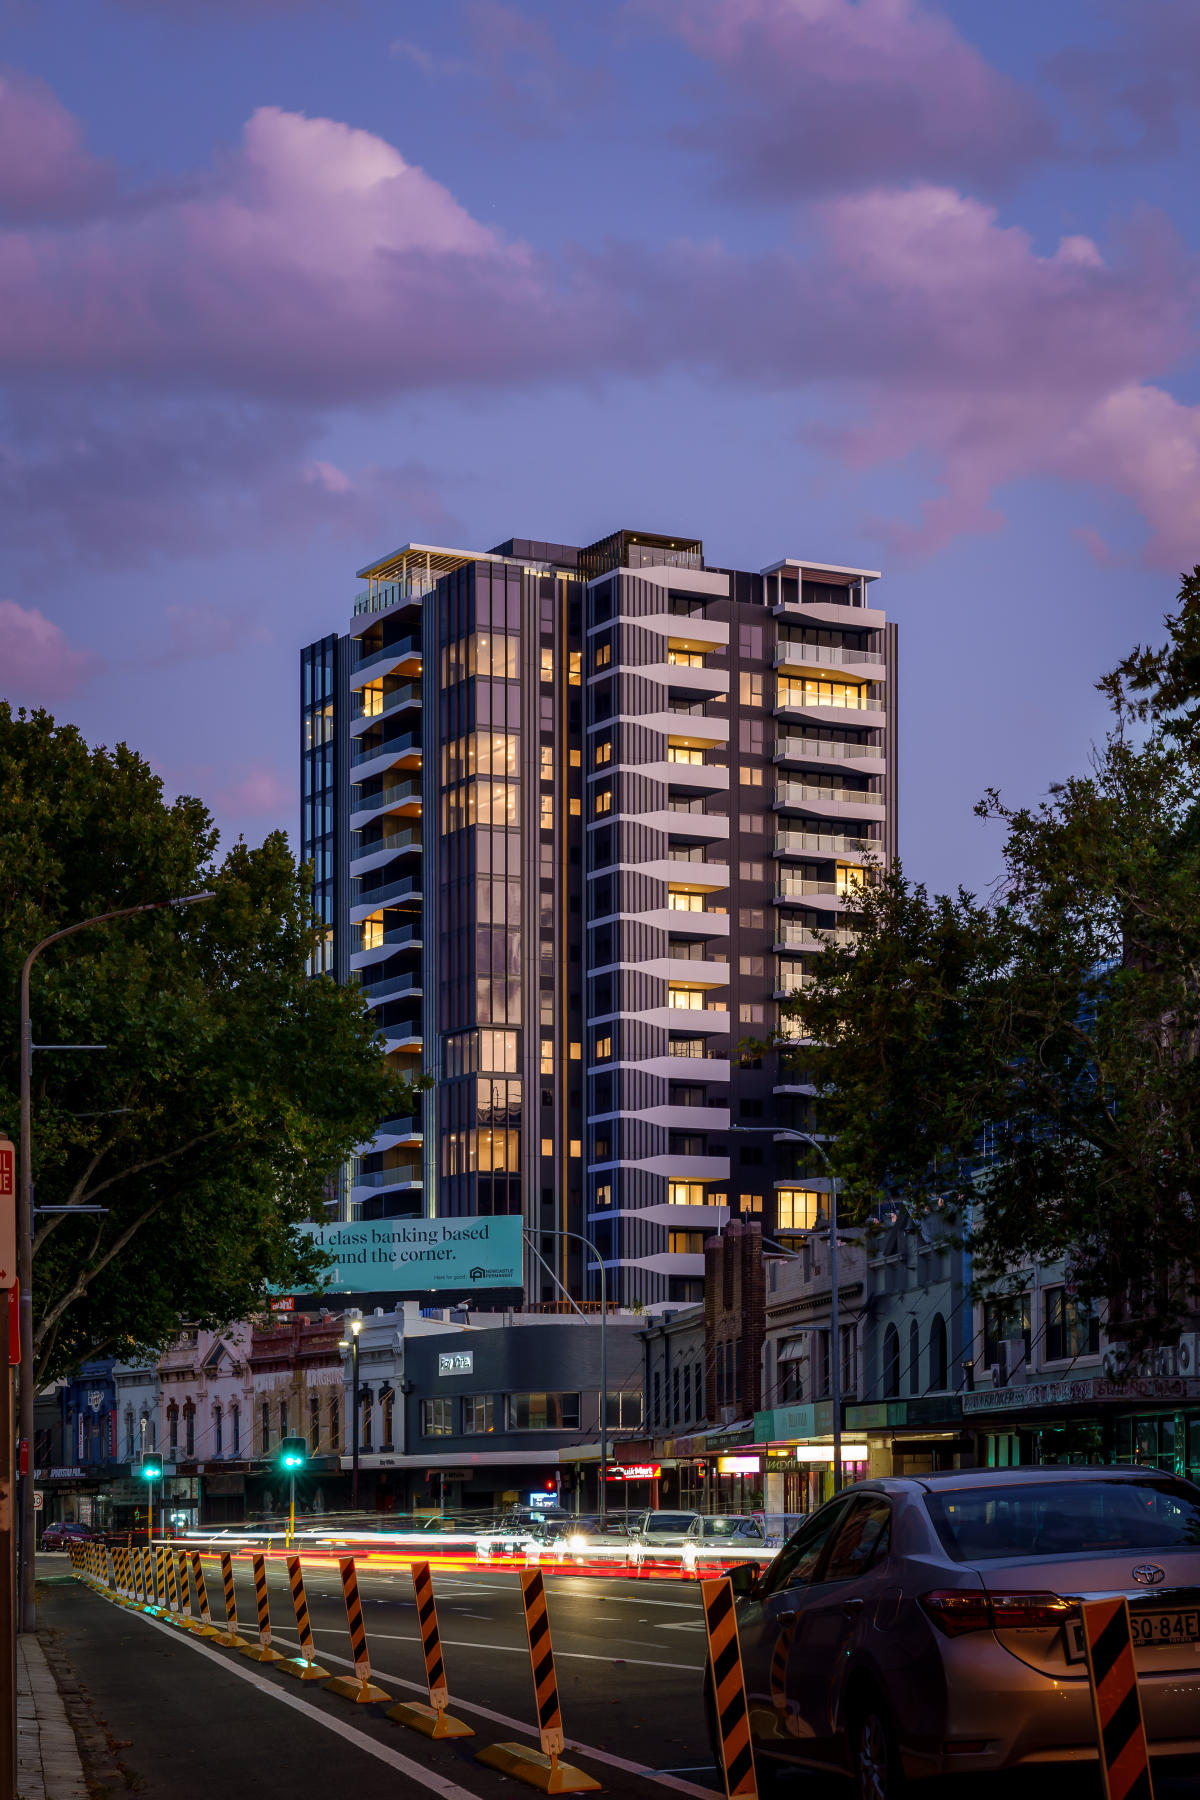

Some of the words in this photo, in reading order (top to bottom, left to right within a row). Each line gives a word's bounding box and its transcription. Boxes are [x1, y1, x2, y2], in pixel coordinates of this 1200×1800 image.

[328, 1230, 368, 1246] class
[371, 1227, 438, 1245] banking
[442, 1224, 489, 1241] based
[371, 1247, 397, 1263] the
[400, 1248, 457, 1262] corner.
